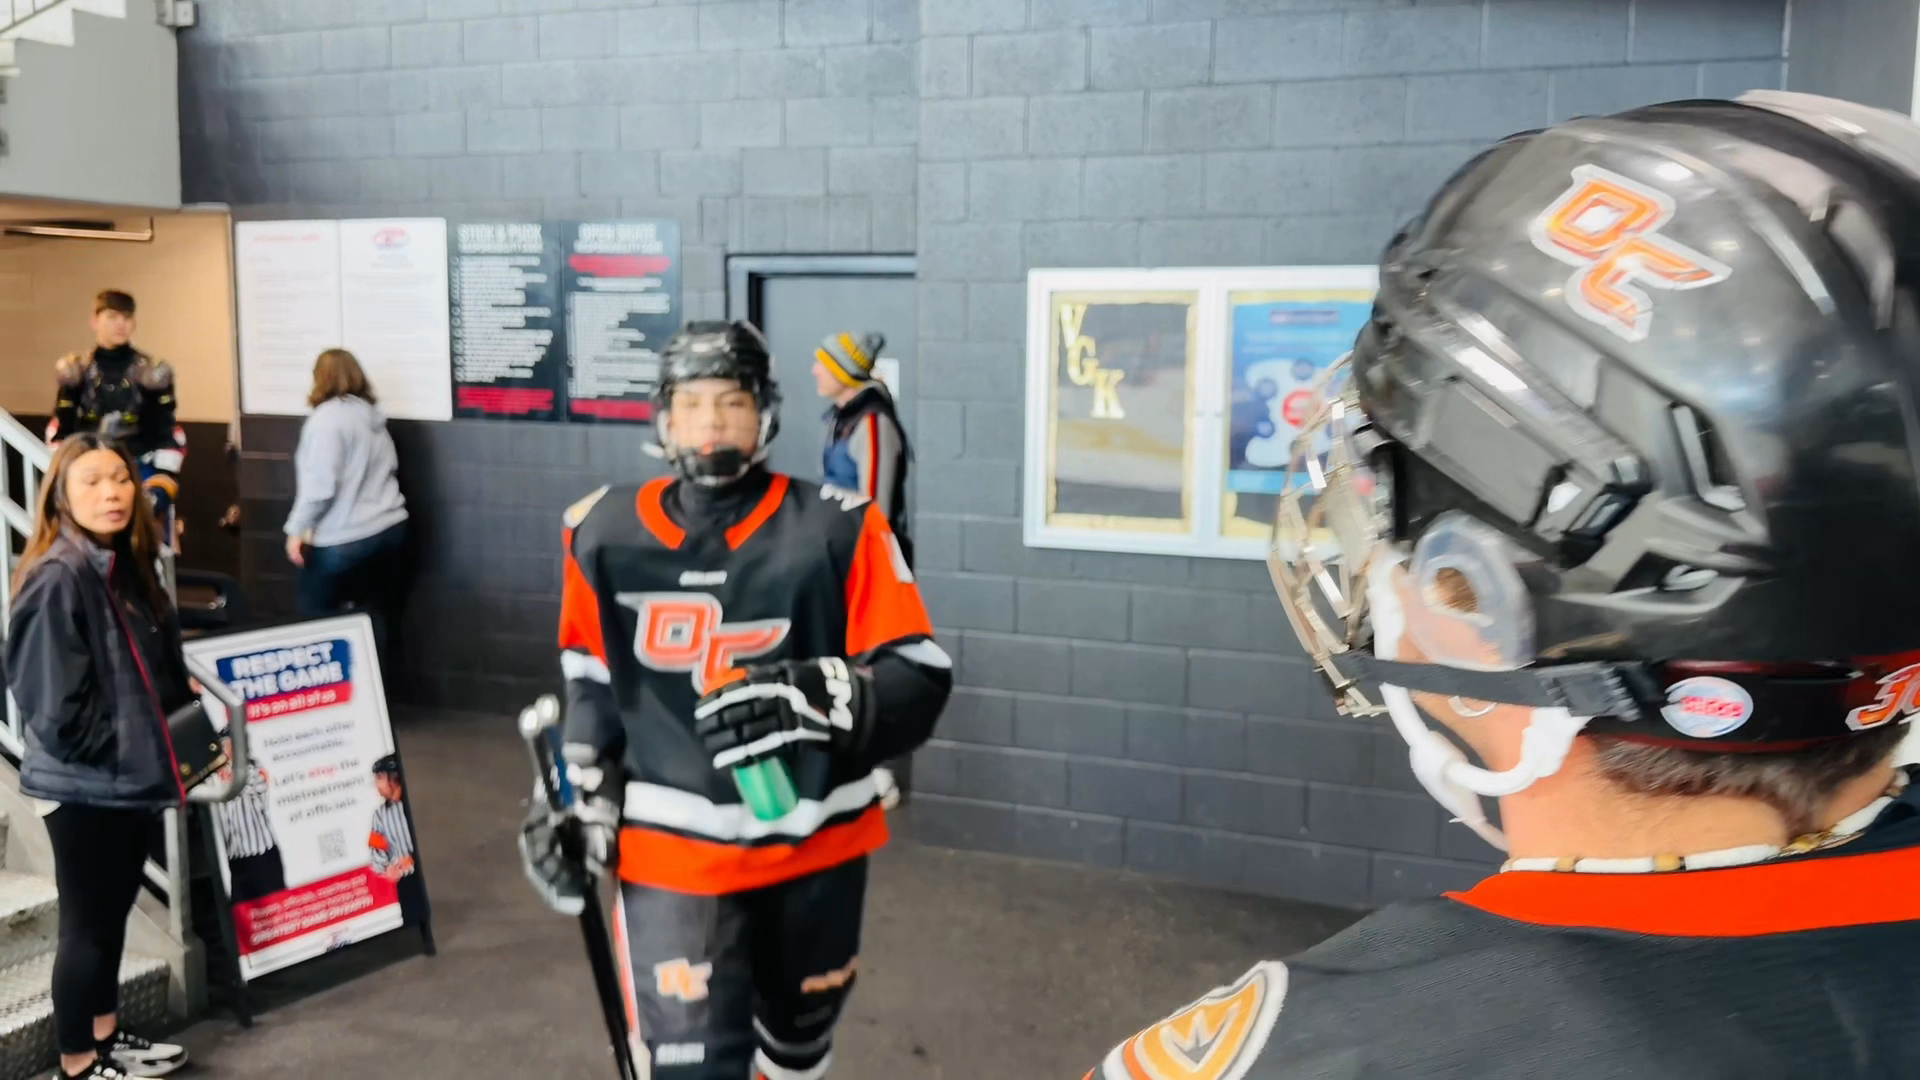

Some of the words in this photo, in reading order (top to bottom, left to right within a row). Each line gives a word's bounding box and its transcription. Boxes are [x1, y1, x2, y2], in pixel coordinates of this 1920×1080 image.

[458, 223, 495, 241] STICK
[507, 223, 542, 241] PUCK
[231, 642, 334, 679] RESPECT
[229, 673, 279, 699] THE
[278, 660, 344, 692] GAME
[248, 702, 272, 719] It's
[271, 699, 288, 715] on
[288, 693, 306, 710] all
[306, 690, 321, 707] of
[307, 764, 338, 779] stop
[340, 759, 360, 771] the
[276, 776, 365, 806] mistreatment
[290, 809, 303, 824] of
